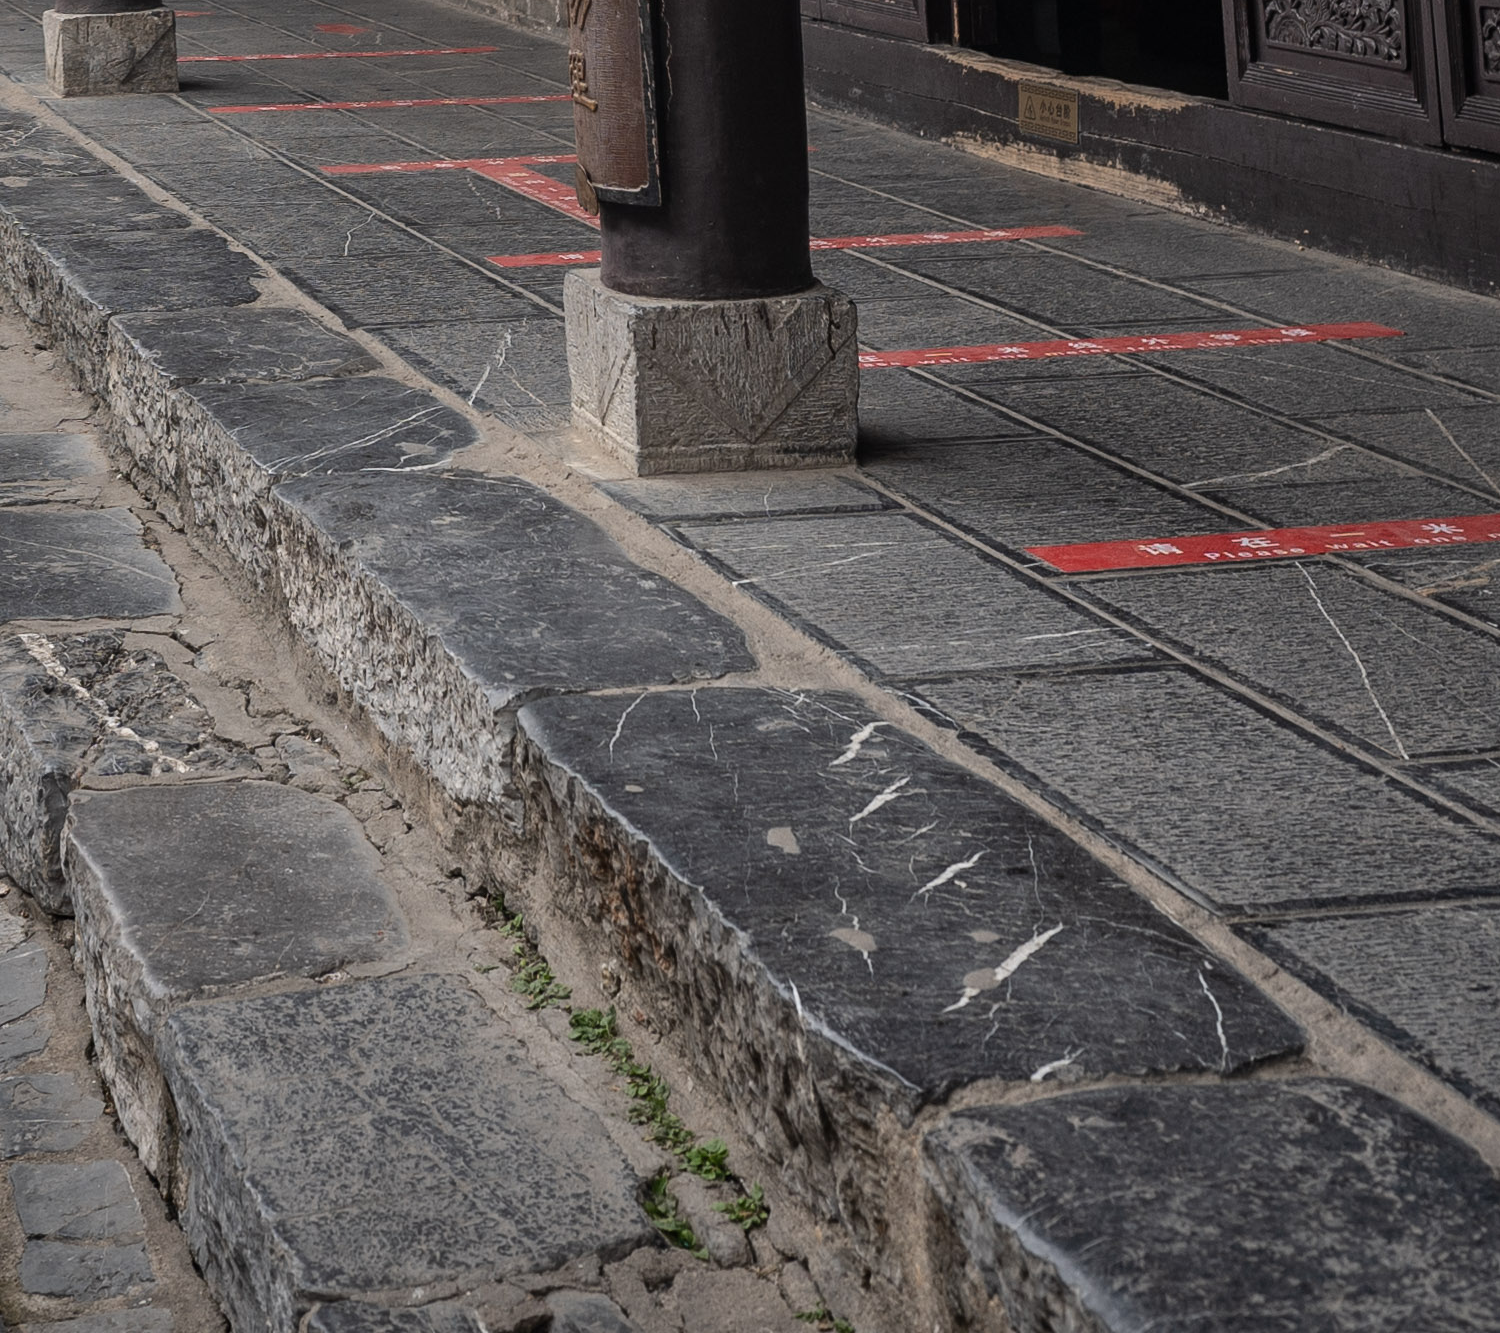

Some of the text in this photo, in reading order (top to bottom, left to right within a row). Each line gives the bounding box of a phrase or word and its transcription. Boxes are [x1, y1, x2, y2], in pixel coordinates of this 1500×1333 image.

[1204, 545, 1305, 561] Please
[1325, 539, 1394, 551] wait
[1414, 534, 1468, 545] one
